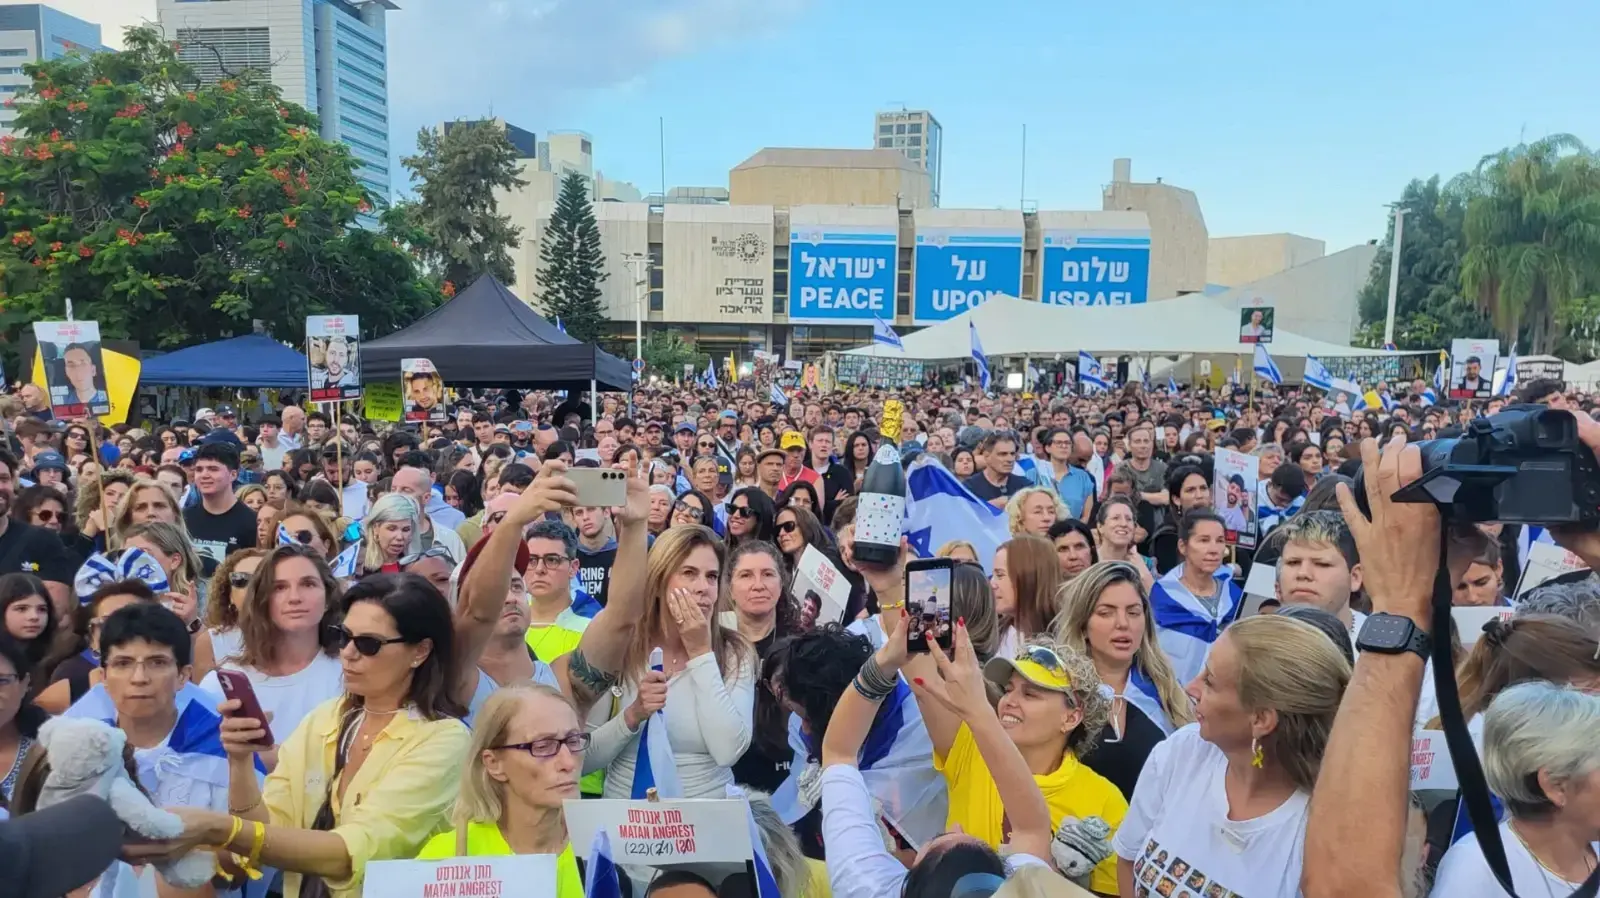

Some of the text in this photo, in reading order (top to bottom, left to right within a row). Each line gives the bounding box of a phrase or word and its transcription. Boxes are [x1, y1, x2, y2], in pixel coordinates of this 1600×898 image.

[801, 251, 887, 279] ישראל
[951, 254, 987, 281] על
[1062, 255, 1130, 283] שלום
[744, 296, 764, 305] בית
[800, 286, 884, 310] PEACE
[580, 567, 605, 581] RING
[618, 824, 696, 840] MATAN ANGREST
[423, 880, 504, 898] MATAN ANGREST
